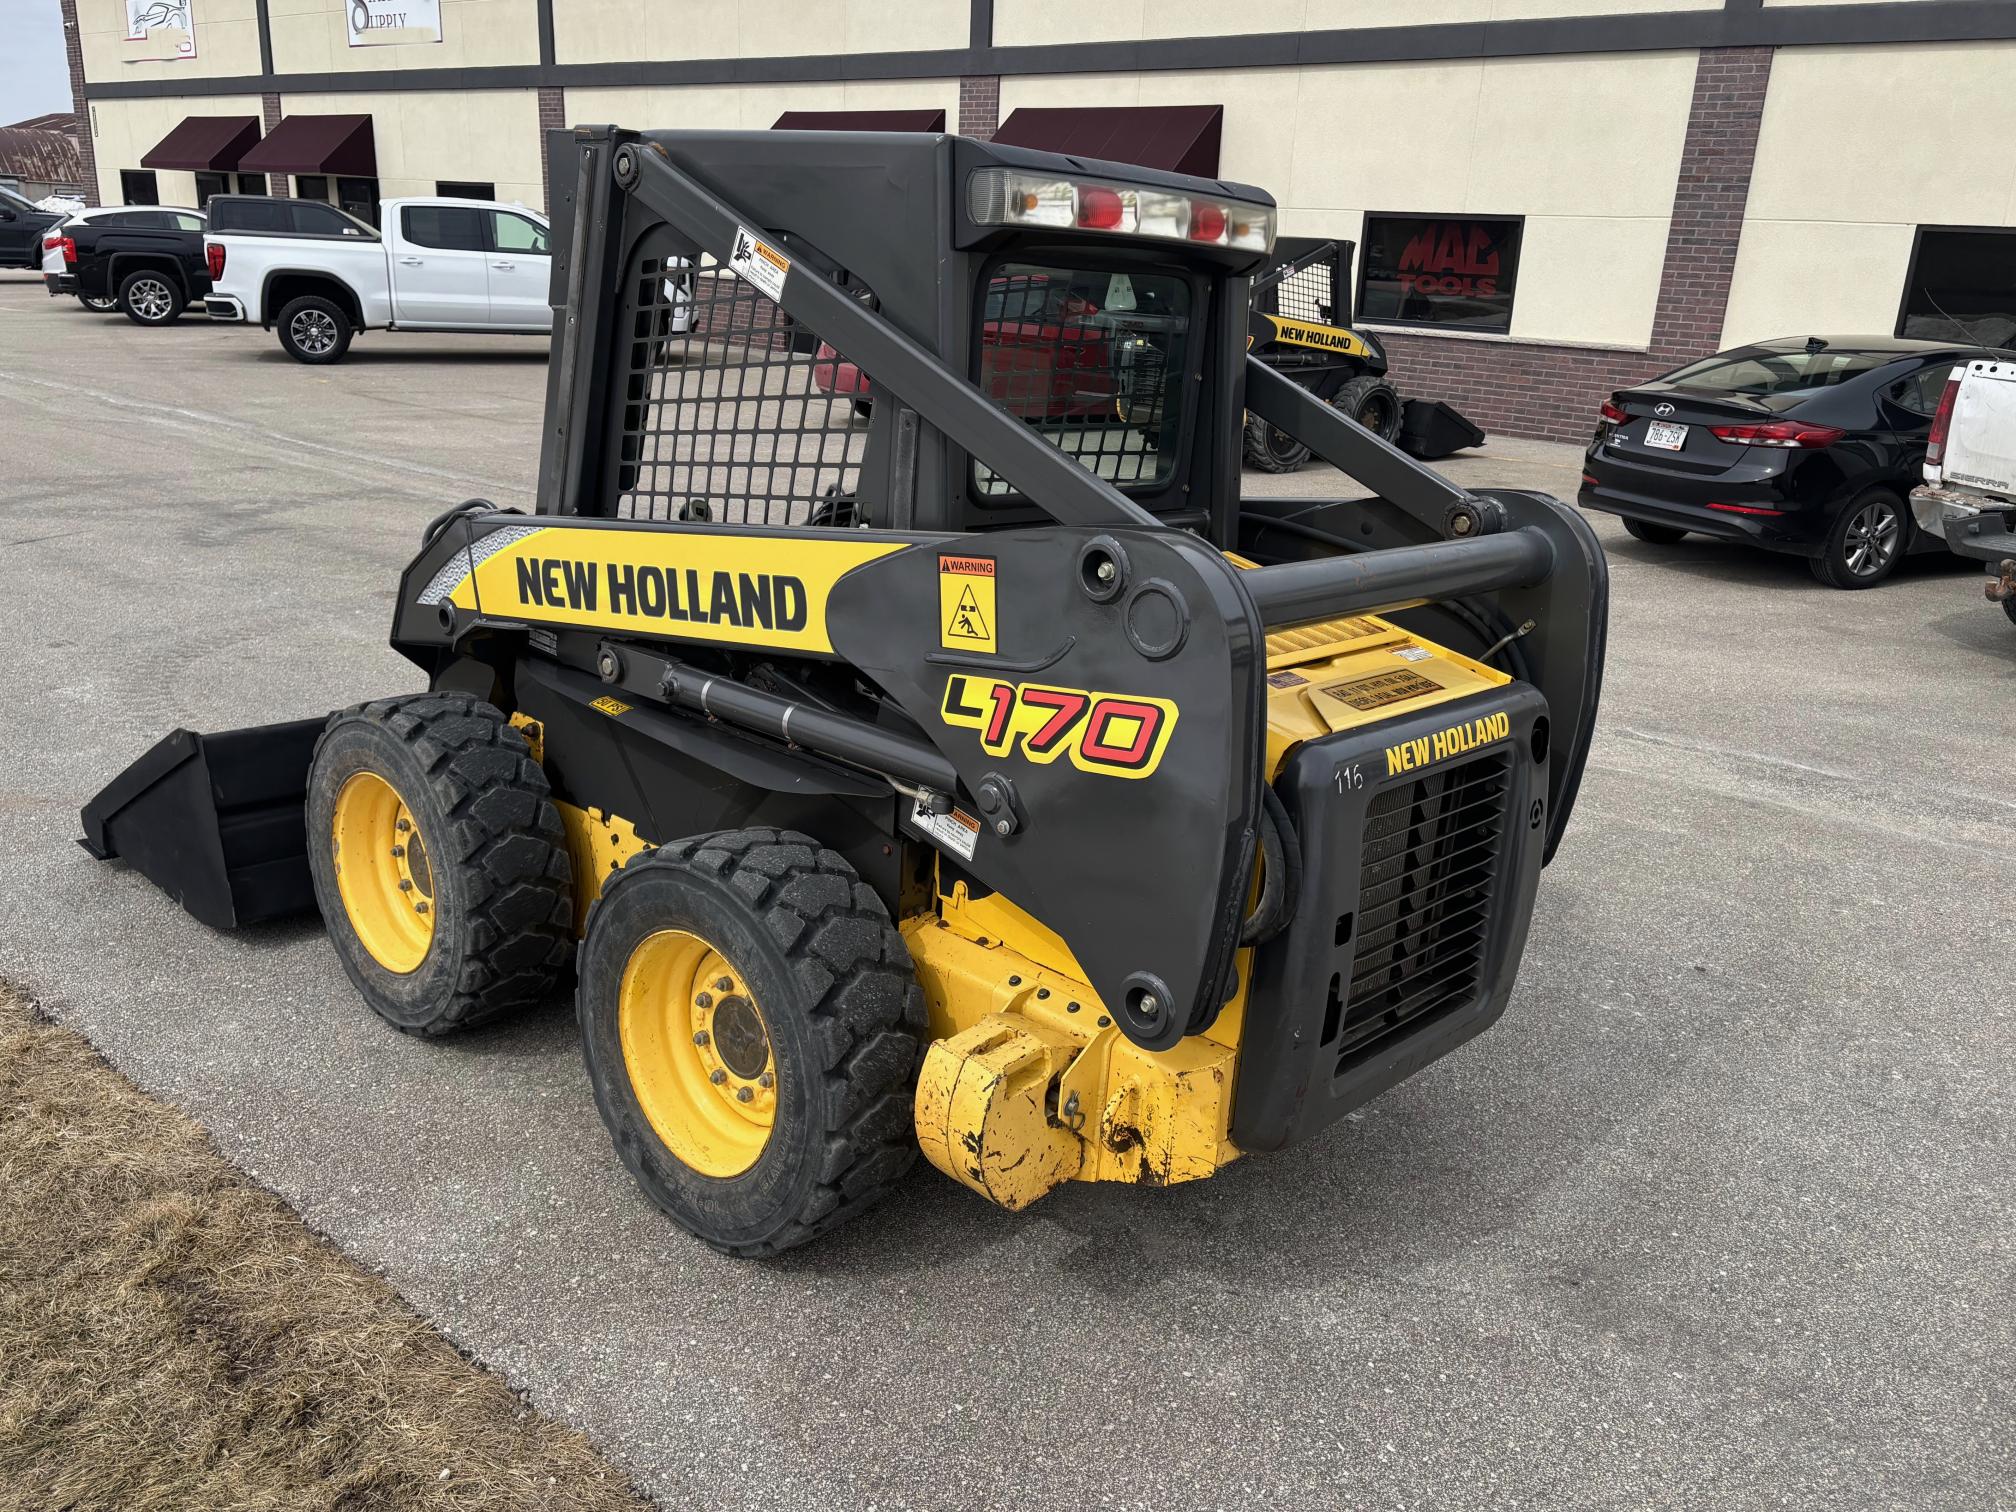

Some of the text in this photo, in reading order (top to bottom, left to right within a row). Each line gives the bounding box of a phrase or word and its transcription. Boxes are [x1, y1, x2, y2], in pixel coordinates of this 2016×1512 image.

[763, 249, 786, 269] WARNING
[1398, 222, 1500, 276] MAC
[1396, 273, 1497, 297] TOOLS
[1280, 325, 1351, 350] NEW HOLLAND
[1949, 471, 2010, 490] SIERRA
[950, 559, 994, 574] WARNING
[515, 556, 808, 633] NEW HOLLAND
[944, 676, 1166, 770] L170
[1385, 711, 1510, 777] NEW HOLLAND
[1334, 763, 1364, 794] 116
[953, 811, 976, 830] ARNING
